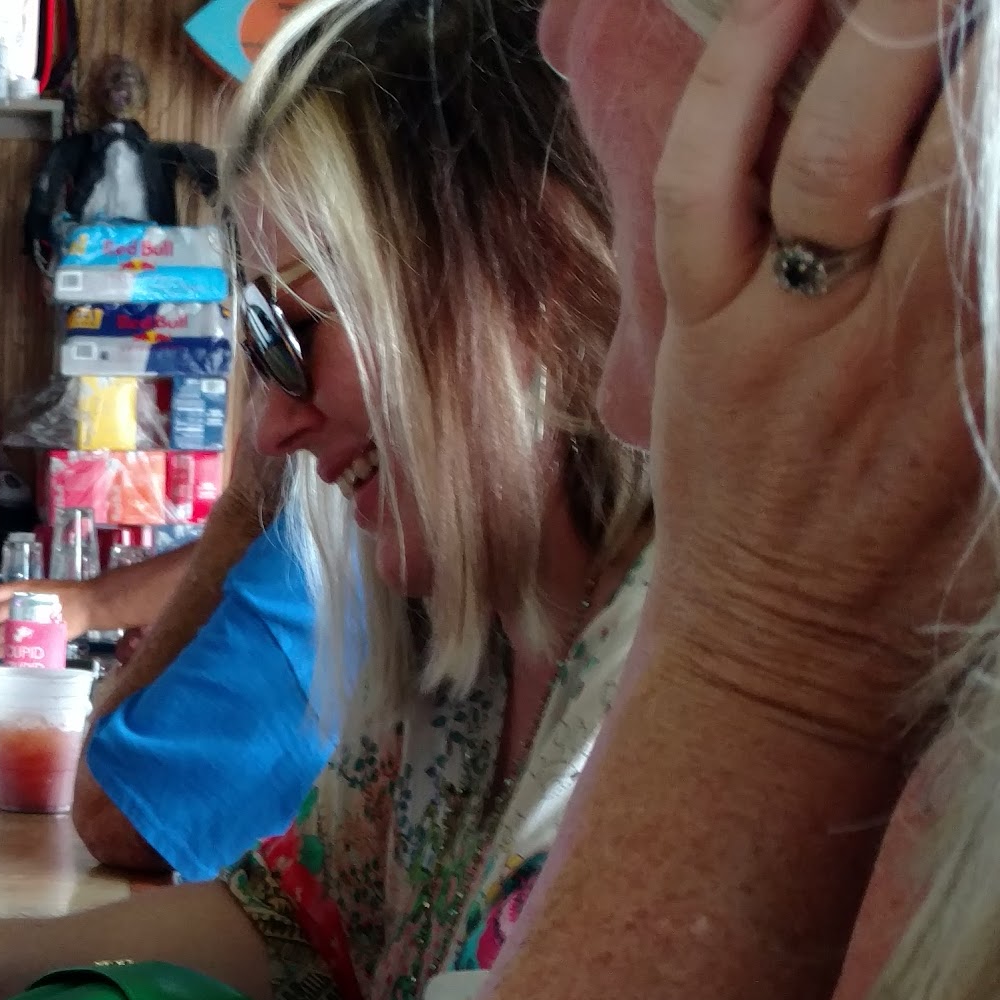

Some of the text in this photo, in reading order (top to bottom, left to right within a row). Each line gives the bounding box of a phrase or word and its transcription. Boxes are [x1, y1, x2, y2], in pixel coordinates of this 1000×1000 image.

[103, 239, 174, 257] Red Bull
[153, 313, 188, 329] Bull
